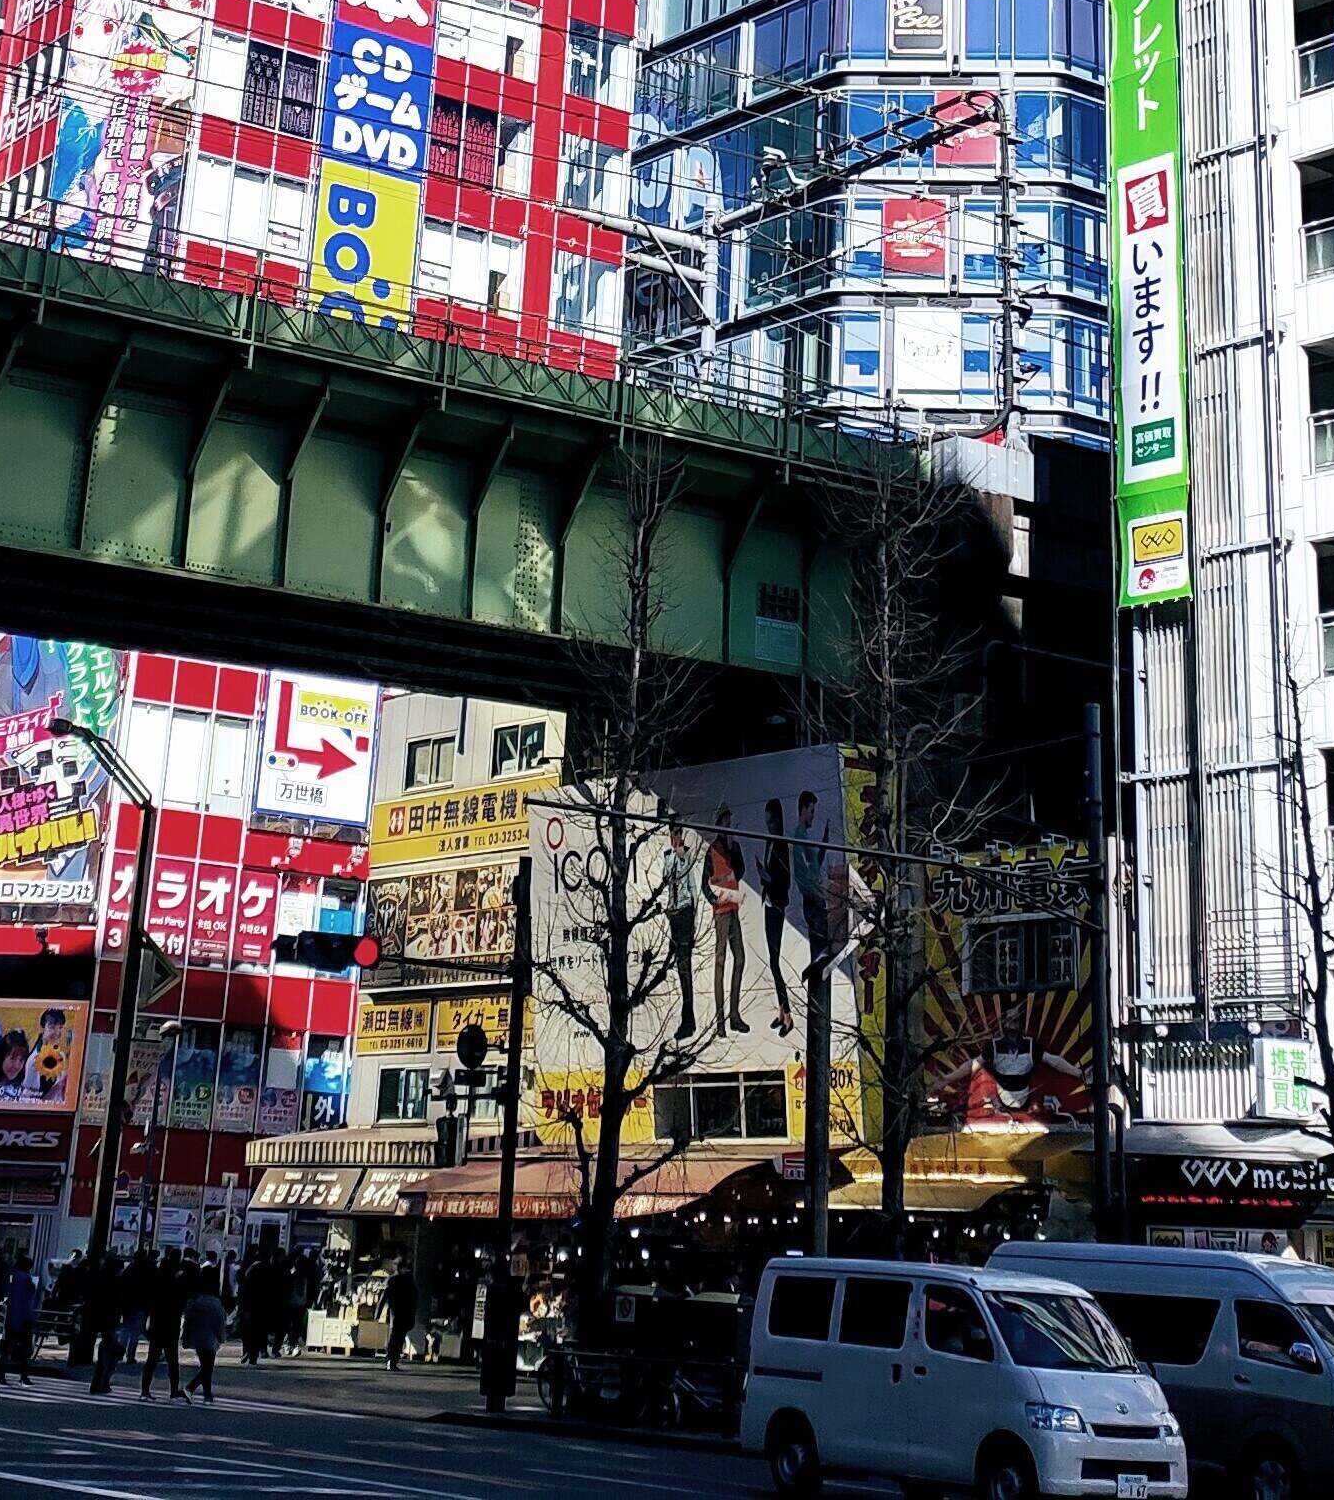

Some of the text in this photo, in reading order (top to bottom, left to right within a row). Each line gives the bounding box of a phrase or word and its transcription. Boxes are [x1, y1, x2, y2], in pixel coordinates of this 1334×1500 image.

[898, 7, 942, 29] Bee
[351, 38, 415, 84] CD
[334, 74, 421, 129] ゲーム
[331, 118, 418, 167] DVD
[1135, 425, 1171, 445] 高価買取
[1135, 442, 1171, 458] センター
[6, 730, 34, 749] 始動!
[279, 781, 325, 805] 万世橋
[408, 788, 518, 834] 田中無線電機
[474, 837, 485, 846] TEL
[554, 851, 638, 894] ICO
[165, 918, 186, 929] Party
[213, 921, 227, 932] OK
[370, 1042, 378, 1050] TEL
[1270, 1046, 1308, 1078] 携帯
[831, 1069, 854, 1089] BOX
[1270, 1079, 1309, 1113] 買取
[260, 1183, 343, 1205] ミツワデンキ
